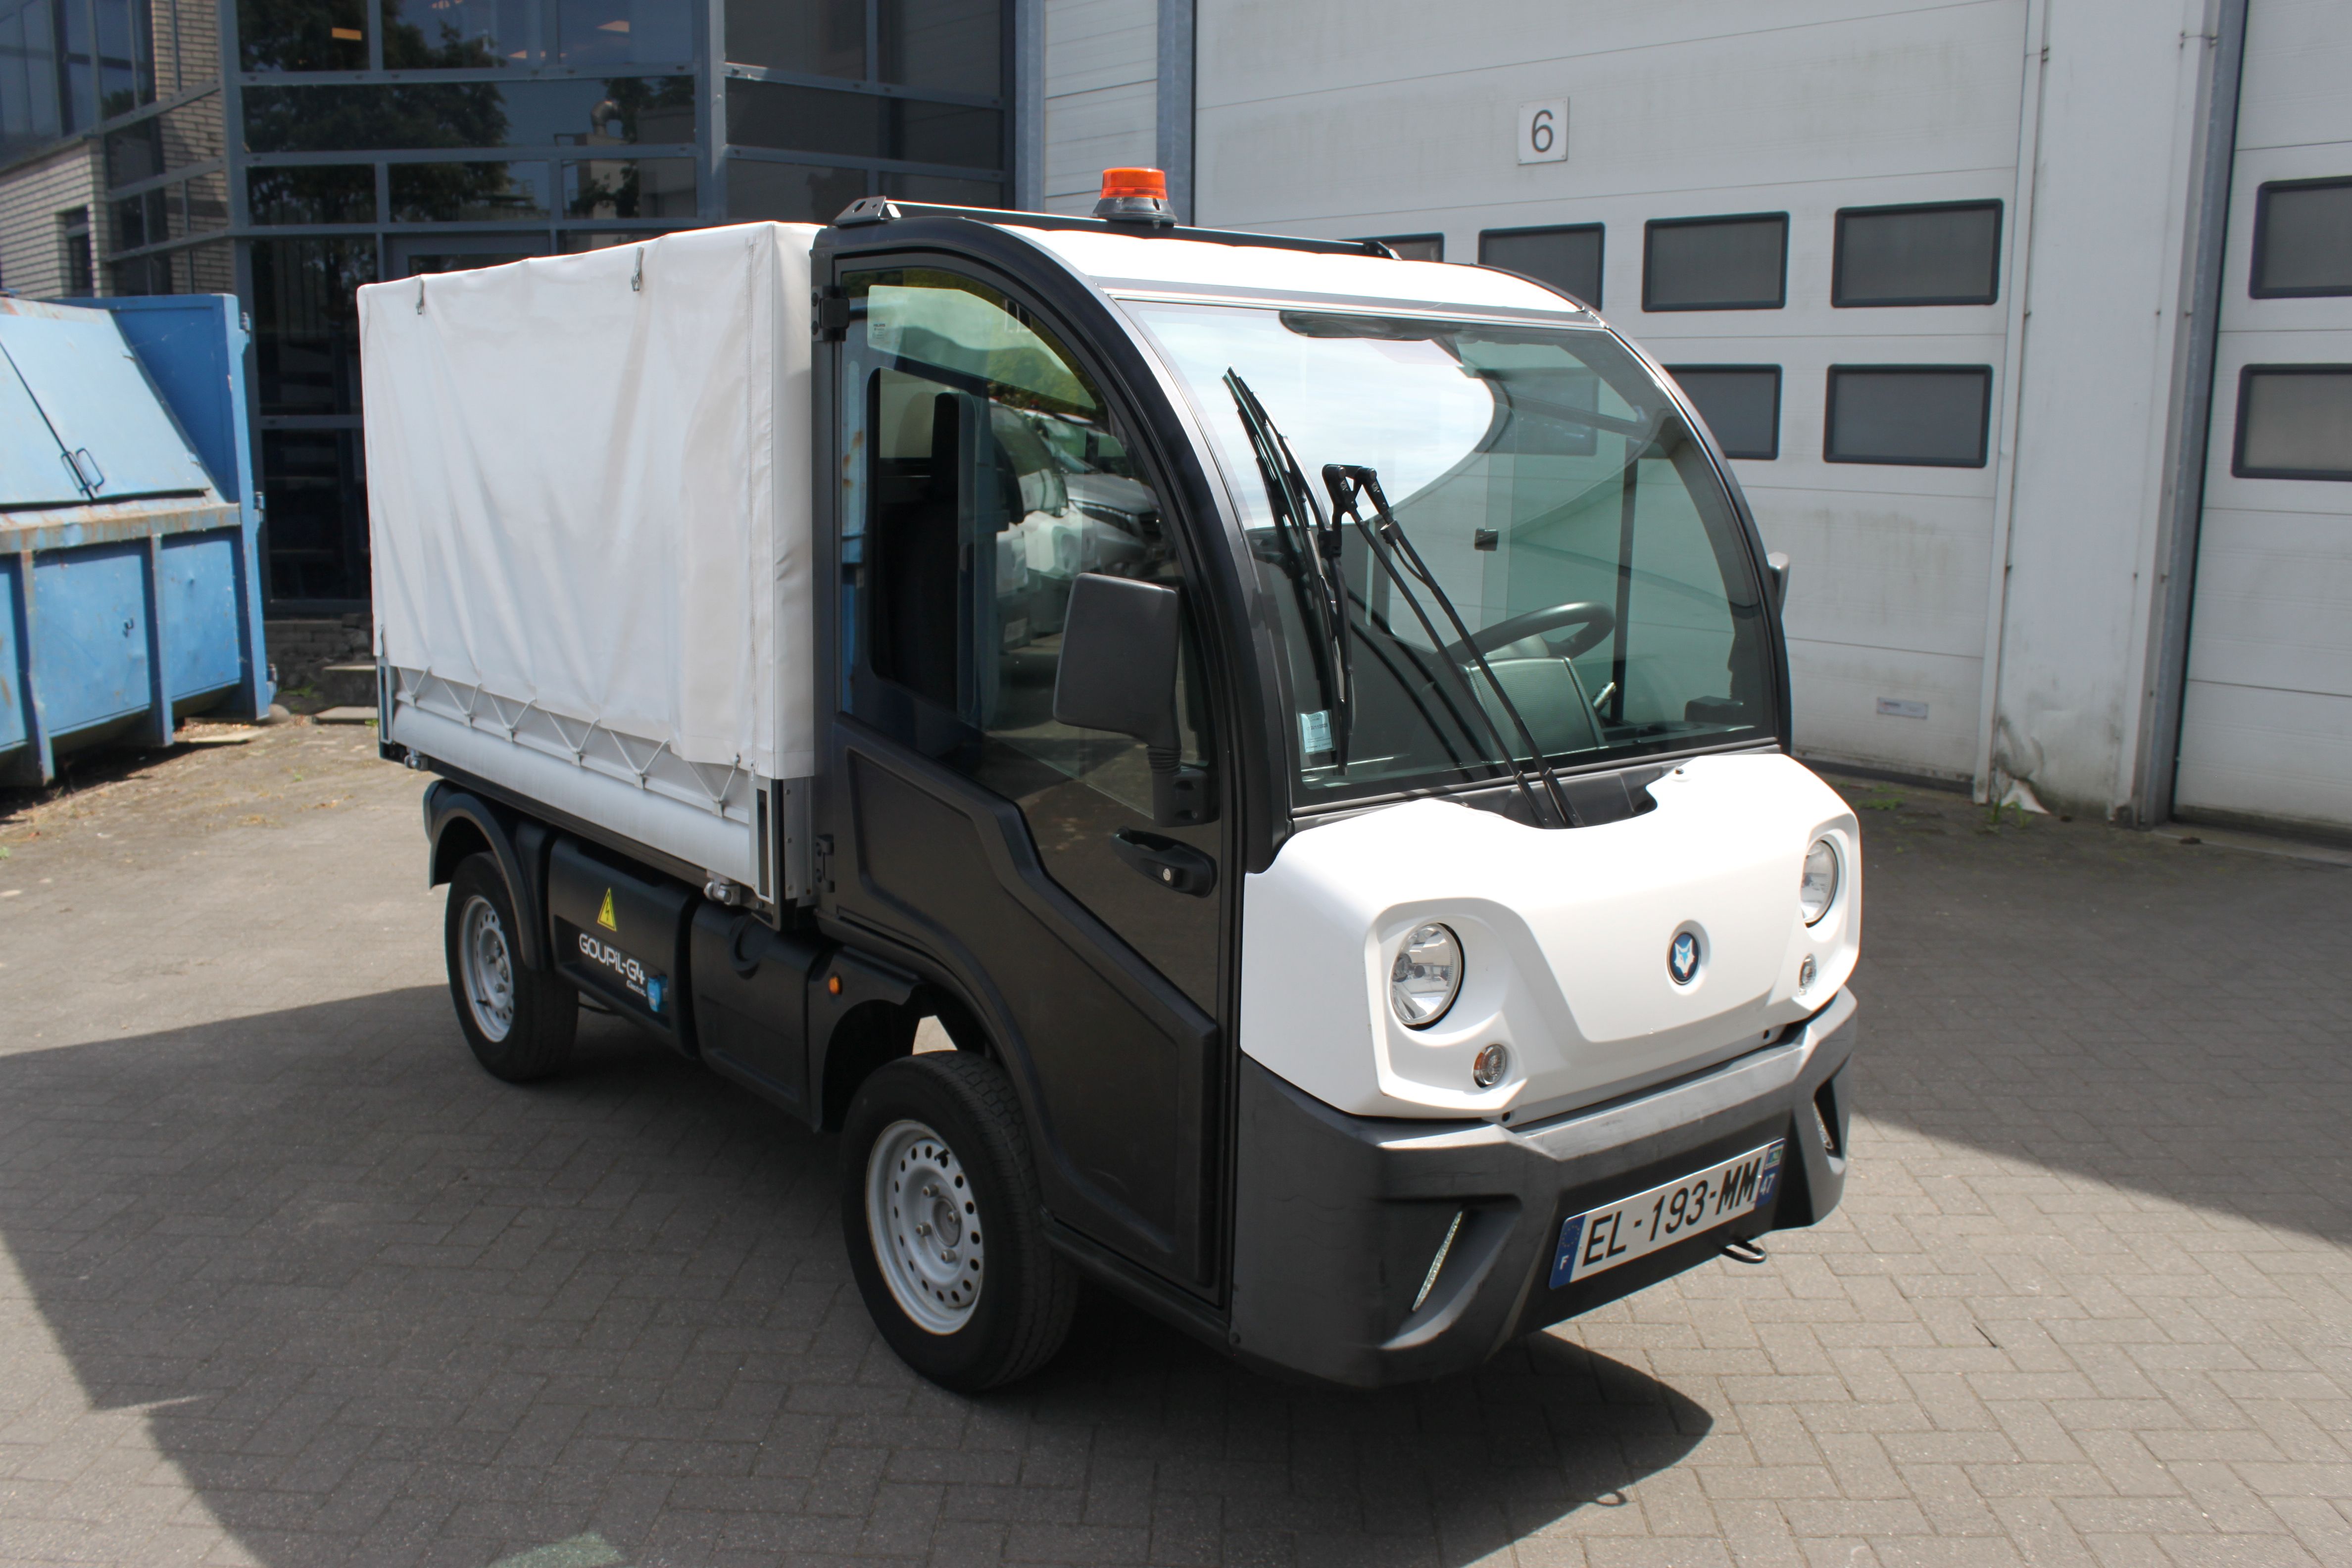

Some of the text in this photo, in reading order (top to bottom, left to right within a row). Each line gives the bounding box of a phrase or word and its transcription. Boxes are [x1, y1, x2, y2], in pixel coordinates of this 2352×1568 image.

[1531, 109, 1553, 152] 6
[1760, 1173, 1776, 1195] 47
[1582, 1157, 1762, 1267] EL-193-MM
[1560, 1255, 1569, 1270] F
